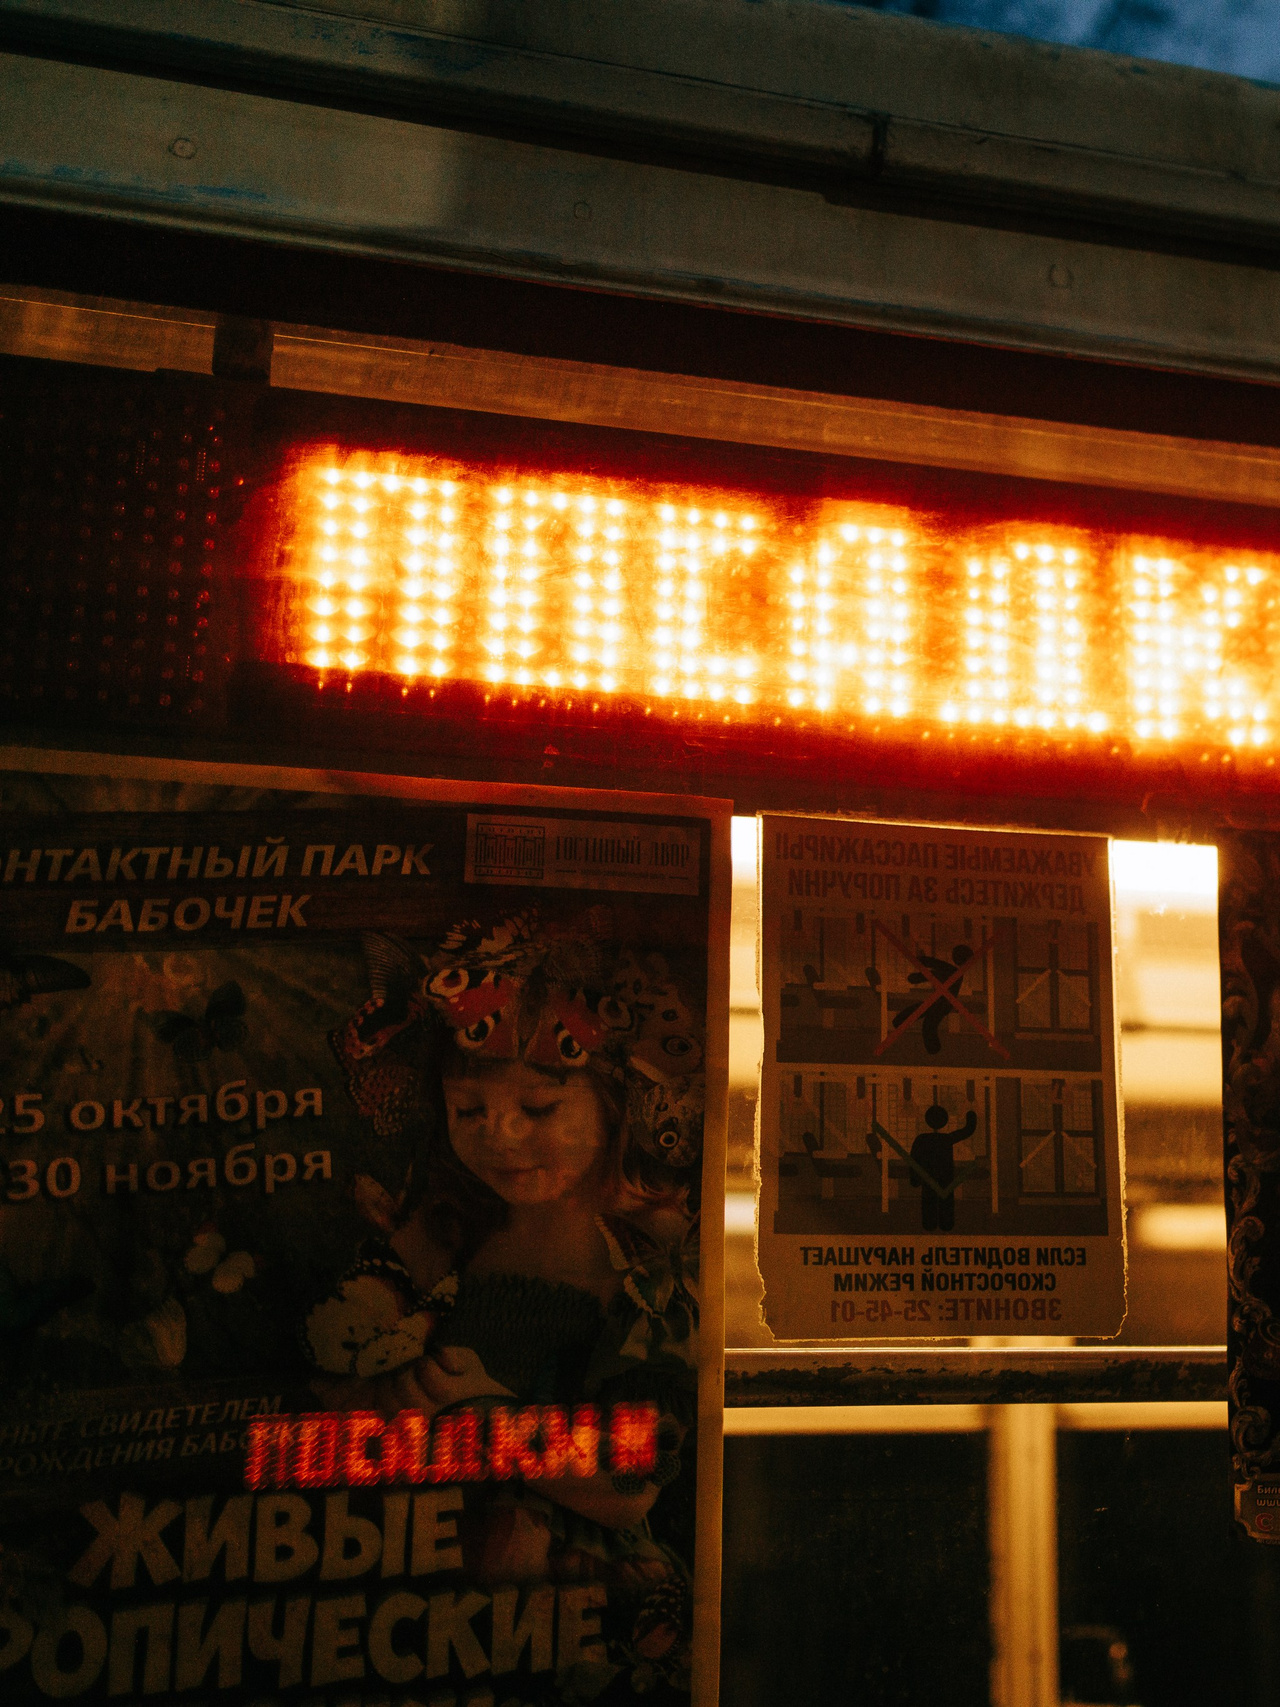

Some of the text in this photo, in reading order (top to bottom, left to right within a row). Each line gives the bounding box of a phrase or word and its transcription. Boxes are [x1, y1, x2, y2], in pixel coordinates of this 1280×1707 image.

[0, 836, 436, 883] НТАКТНЫЙ ПАРК
[555, 835, 691, 869] ГОСТИНЫЙ ДВОР
[64, 894, 313, 934] БАБОЧЕК
[0, 1080, 323, 1134] 5 октября
[6, 1142, 334, 1200] 30 ноября
[80, 1394, 283, 1440] СВИДЕТЕЛЕМ
[68, 1486, 466, 1591] ЖИВЫЕ
